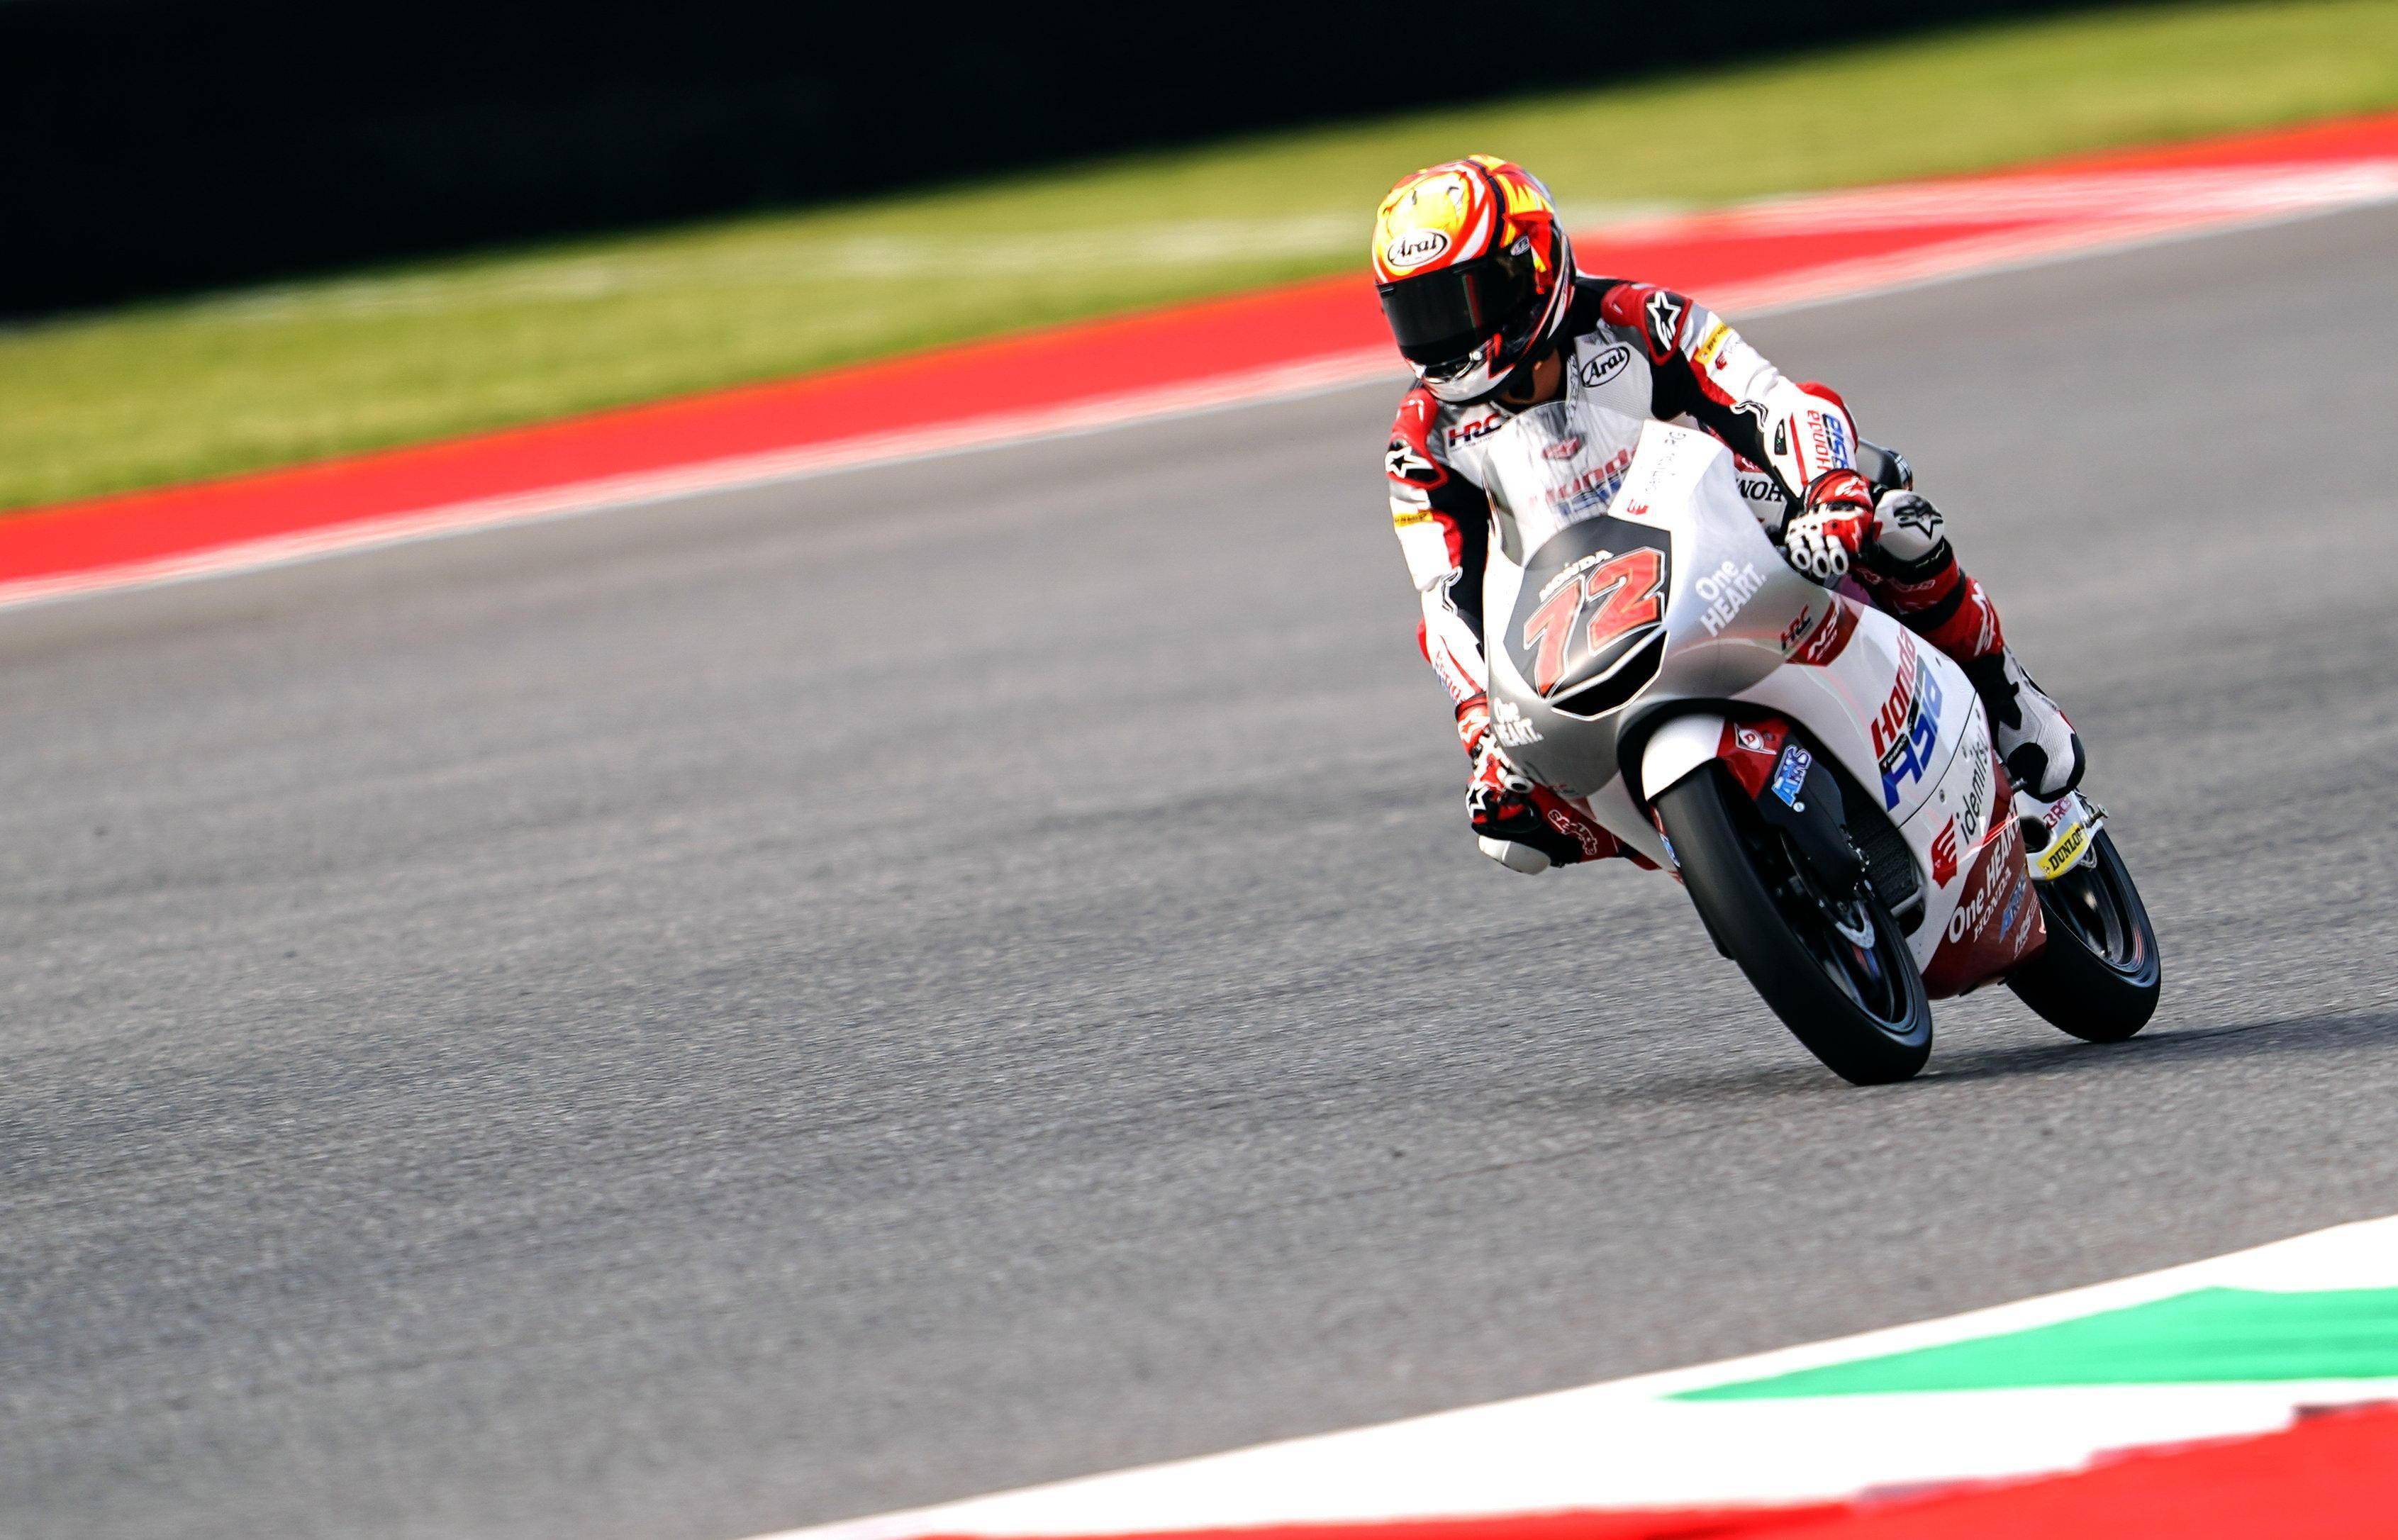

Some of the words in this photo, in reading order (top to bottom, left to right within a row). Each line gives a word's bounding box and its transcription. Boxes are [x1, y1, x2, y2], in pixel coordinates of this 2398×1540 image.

[1585, 347, 1625, 385] Arai
[1449, 412, 1503, 447] HRC
[1695, 561, 1739, 601] One
[1700, 562, 1767, 637] HEART.
[1524, 546, 1666, 701] 72
[1870, 623, 1917, 760] Honda
[2048, 827, 2083, 871] DUNLOP
[1949, 887, 1985, 944] One
[1973, 866, 2012, 943] HONDA
